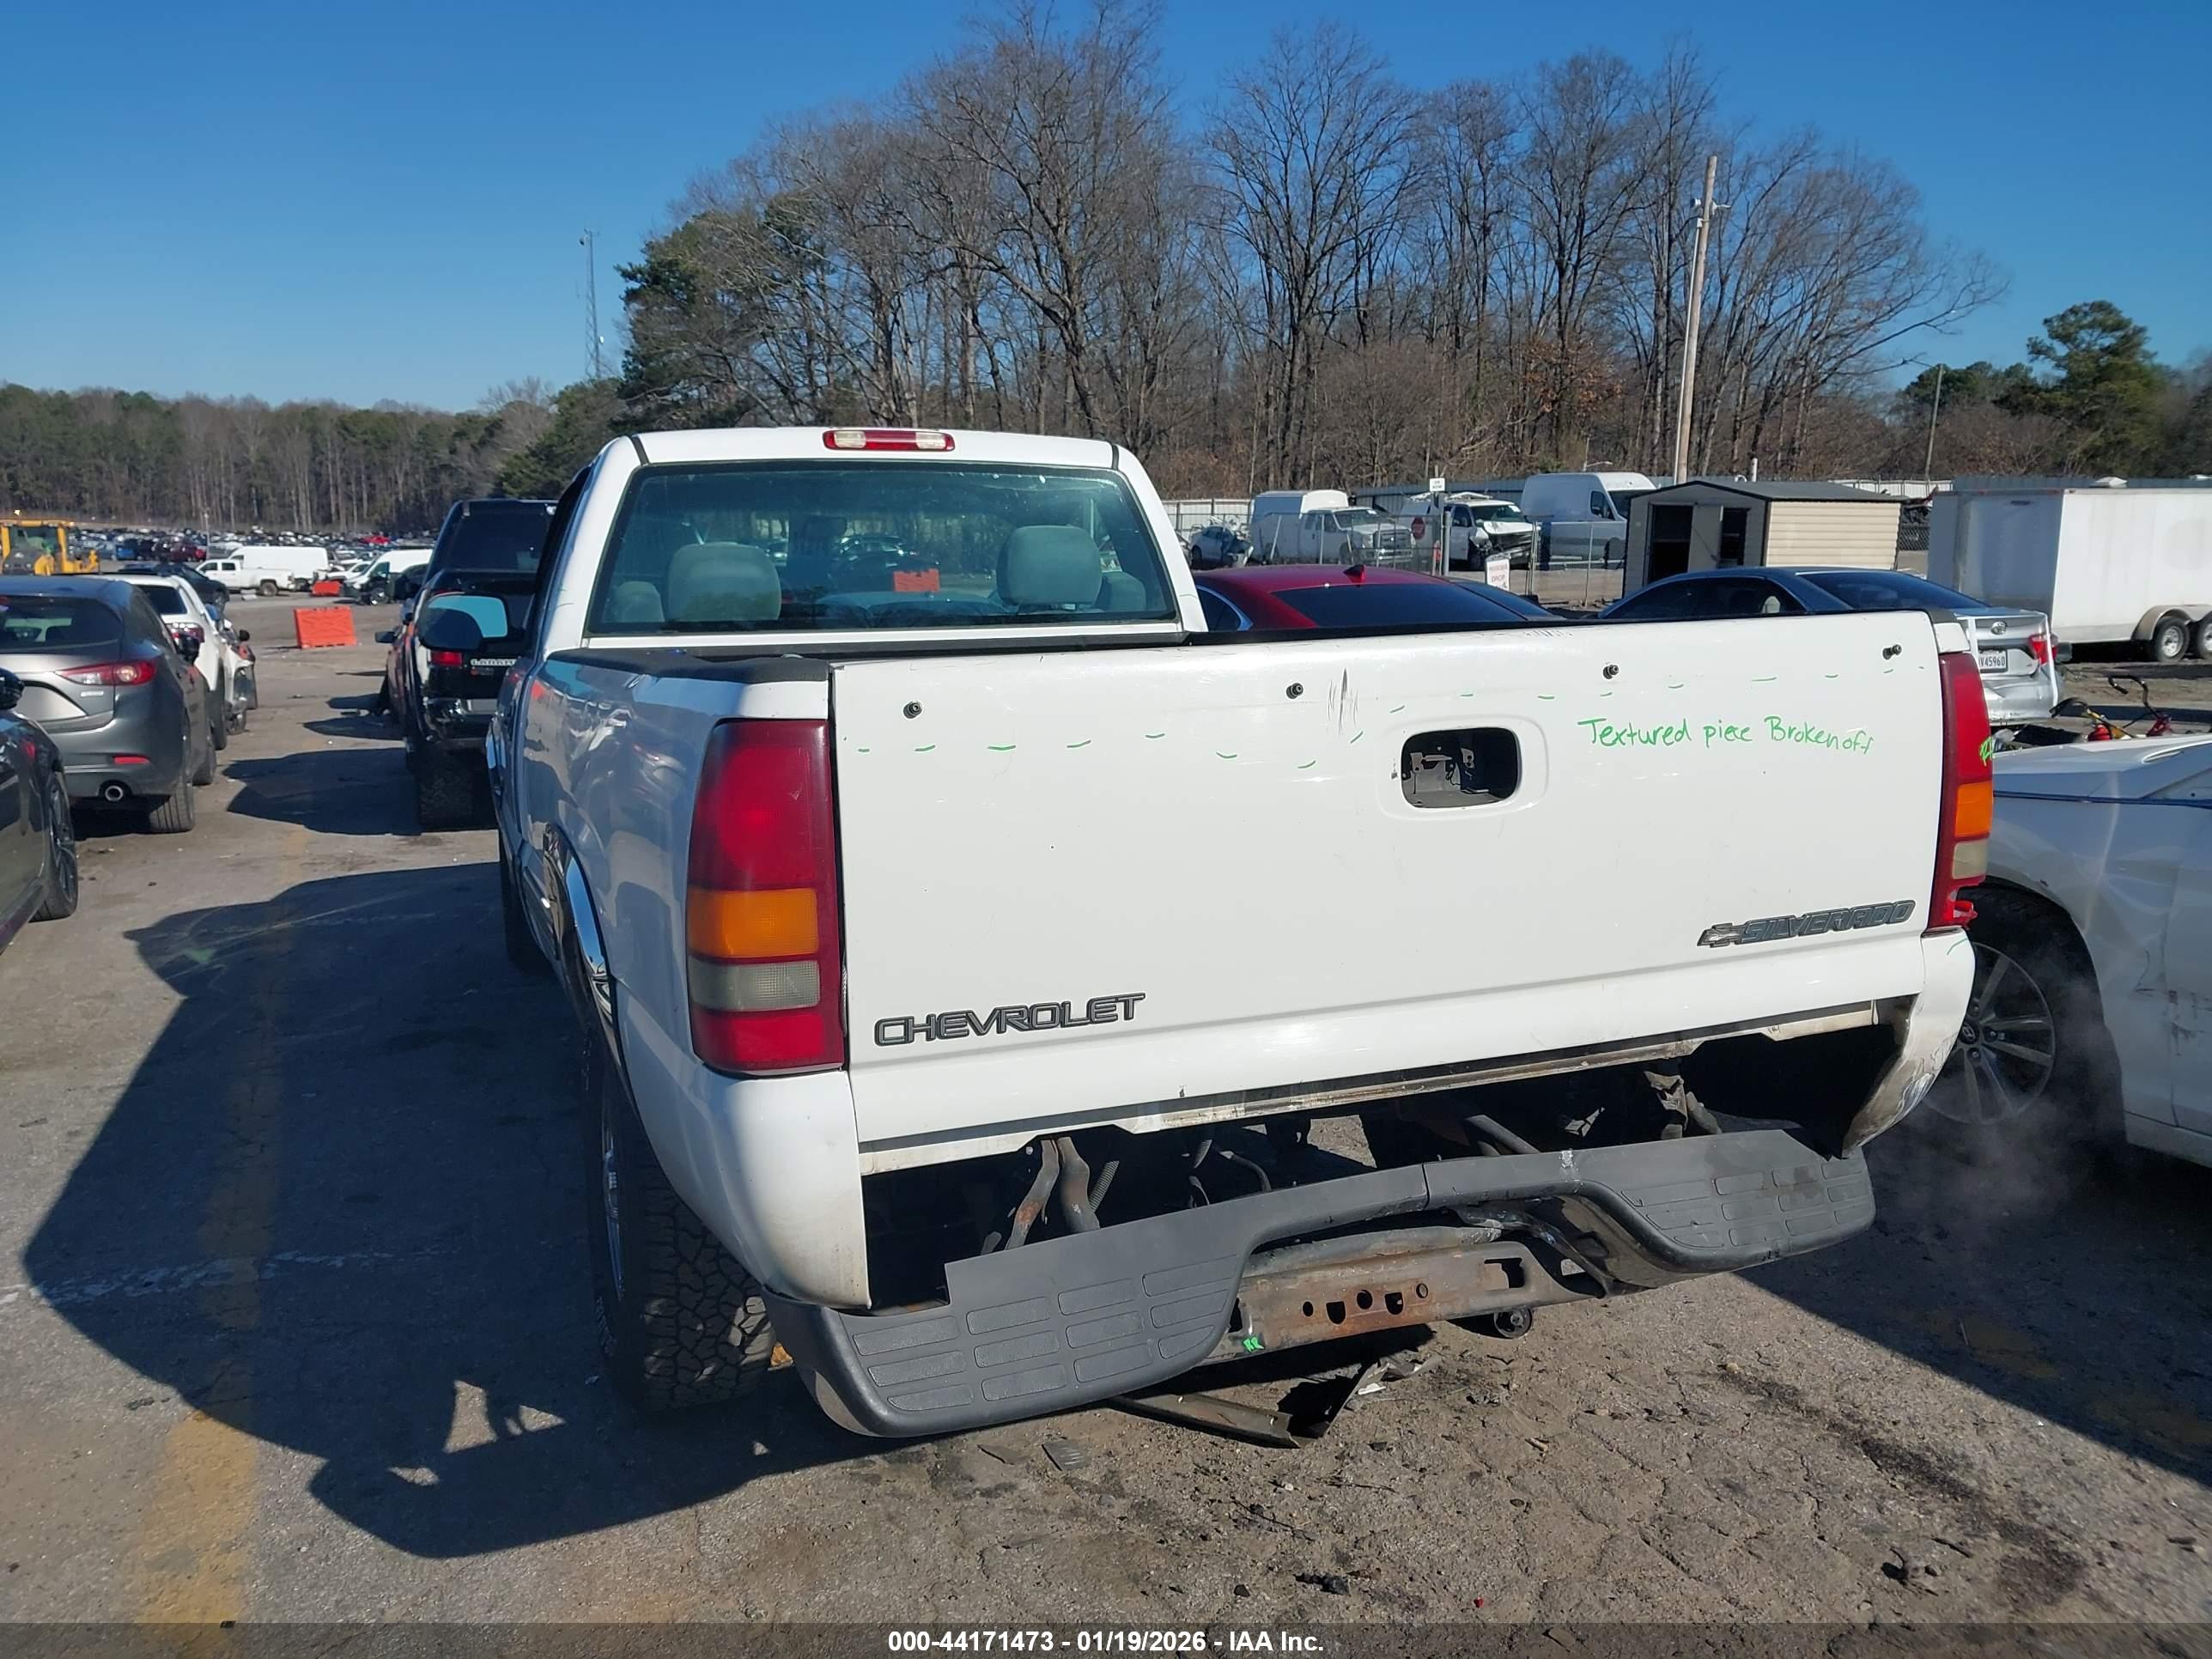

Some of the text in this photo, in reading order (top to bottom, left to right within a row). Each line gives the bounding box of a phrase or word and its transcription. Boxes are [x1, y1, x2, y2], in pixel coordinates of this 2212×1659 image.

[1577, 718, 1692, 746] Textured
[1703, 719, 1753, 748] piece
[1738, 899, 1916, 945] SILVERADO
[874, 992, 1146, 1047] CHEVROLET
